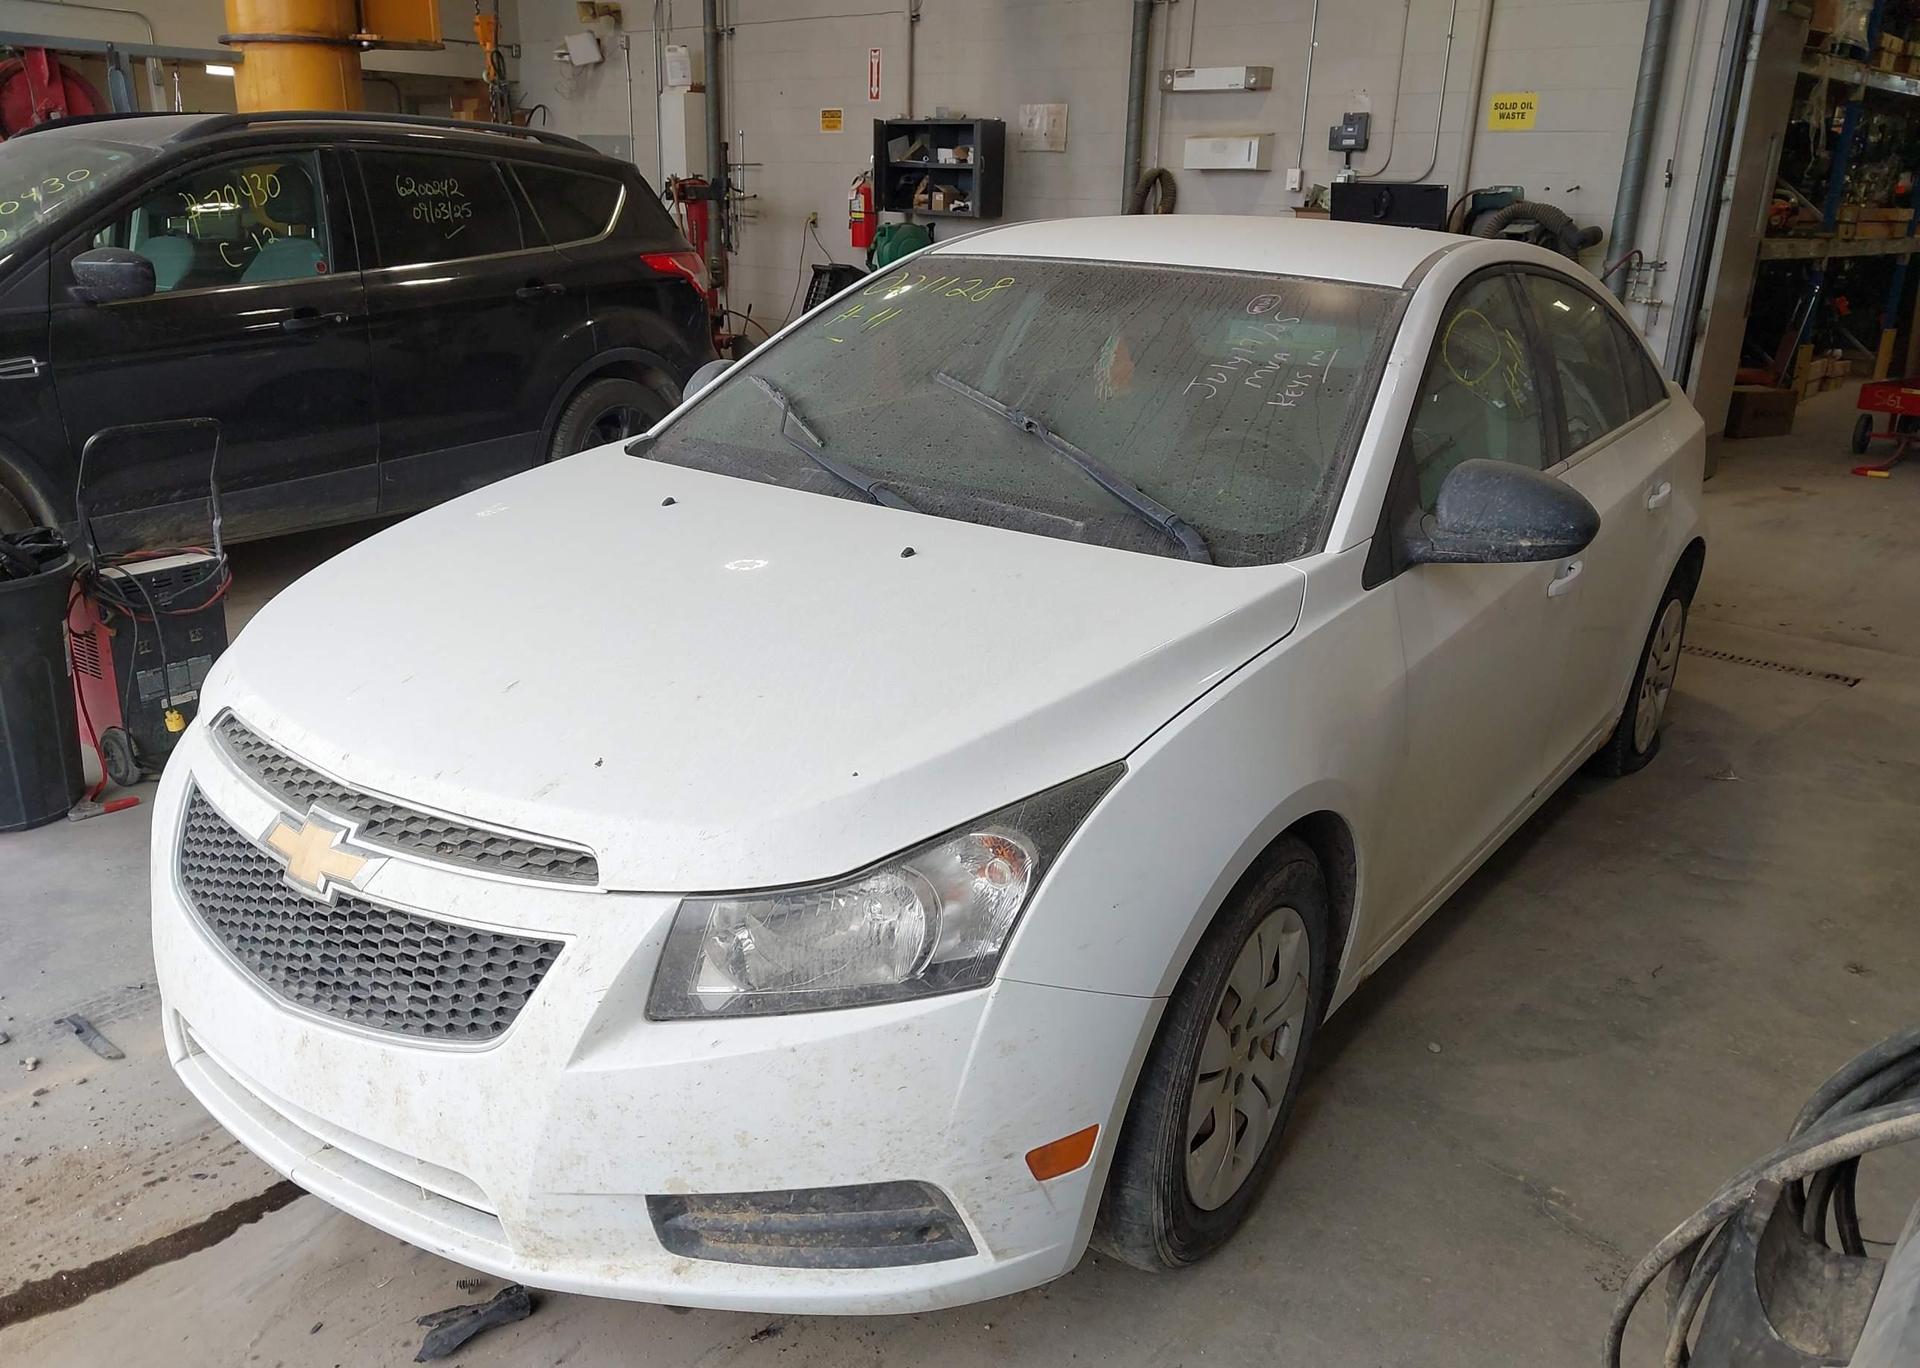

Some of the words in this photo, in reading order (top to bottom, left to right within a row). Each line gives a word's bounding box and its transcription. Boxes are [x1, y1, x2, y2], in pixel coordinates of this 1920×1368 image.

[1494, 102, 1518, 110] SOLID
[1520, 102, 1534, 110] OIL
[1499, 111, 1526, 120] WASTE
